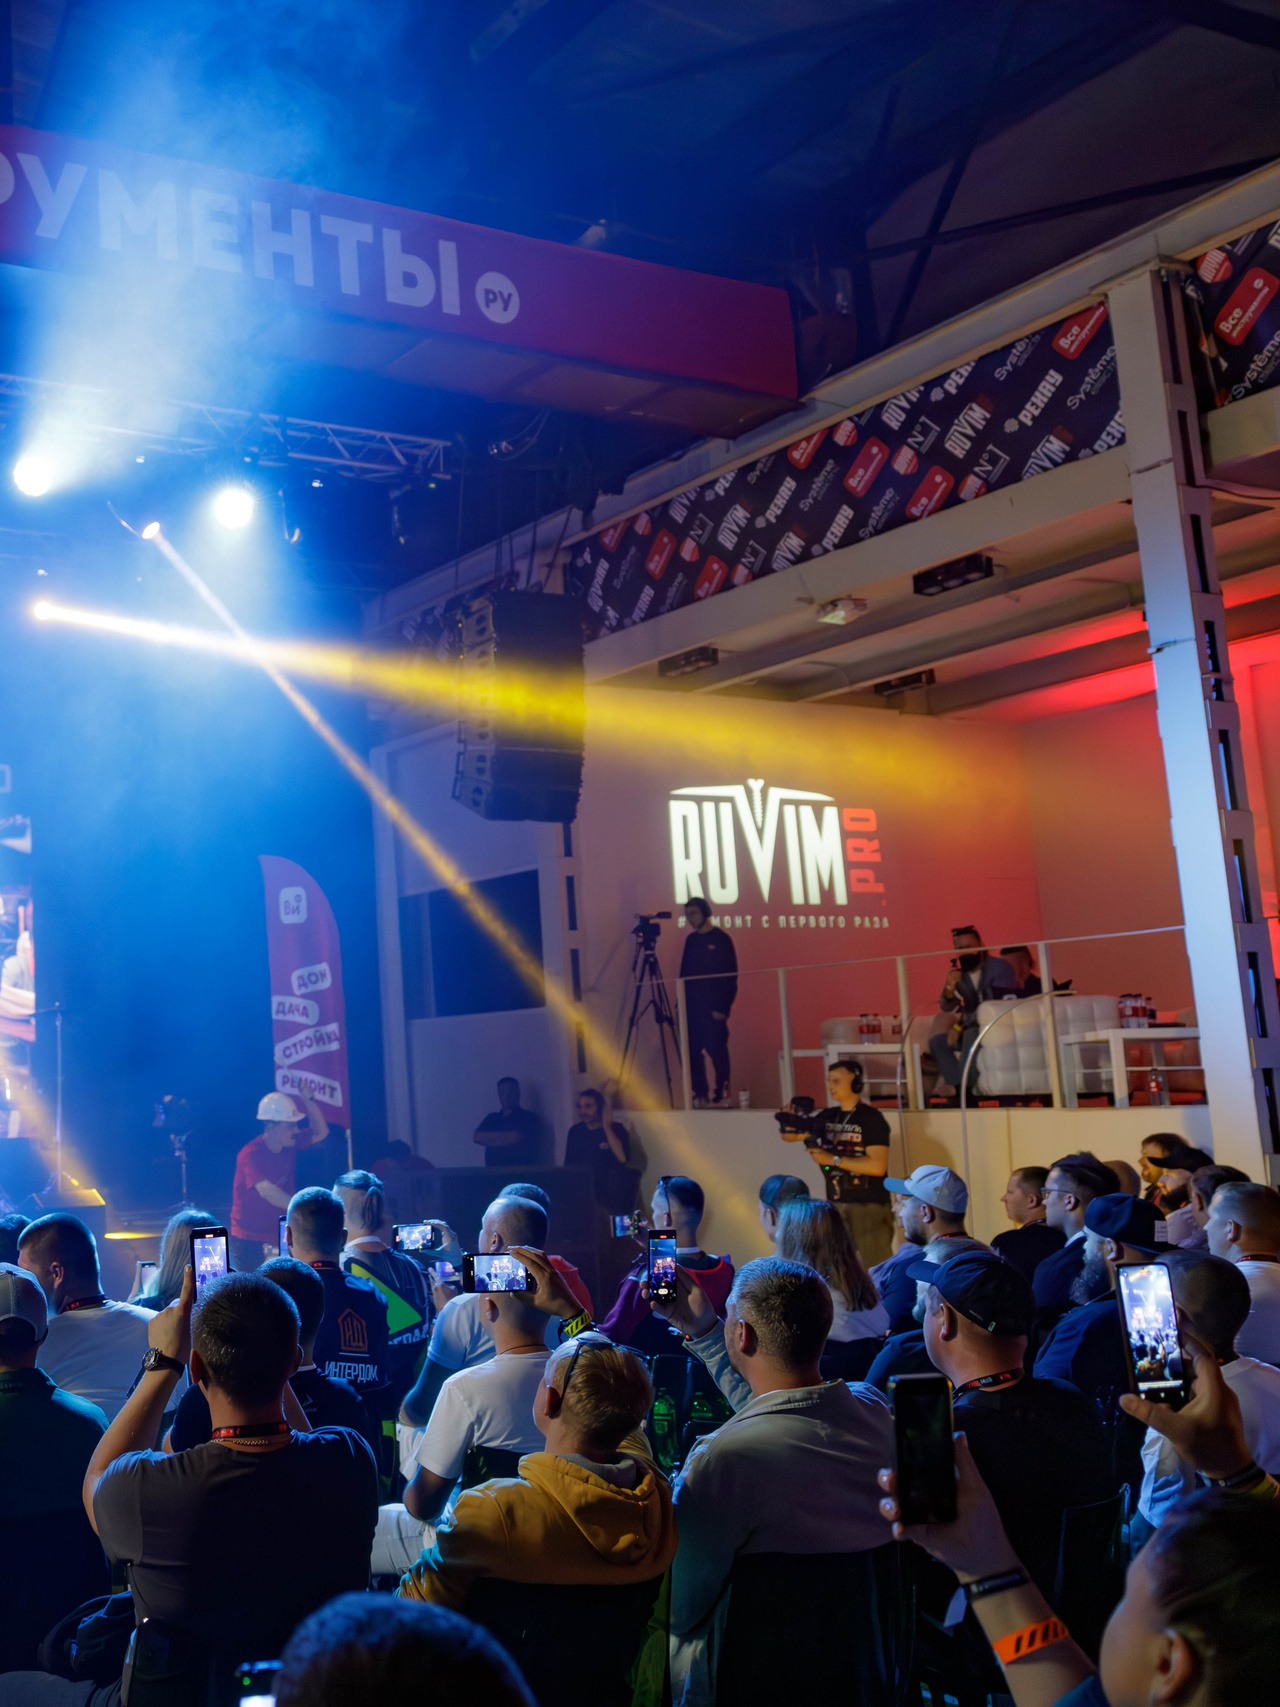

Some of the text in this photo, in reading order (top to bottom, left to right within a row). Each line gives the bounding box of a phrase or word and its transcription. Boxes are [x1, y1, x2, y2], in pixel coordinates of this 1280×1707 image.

[944, 401, 991, 460] RUVIM
[668, 784, 848, 906] RUVIM
[778, 915, 846, 929] ПЕРВОГО
[853, 915, 890, 929] РАЗА
[275, 1001, 310, 1019] ДАЧА
[324, 1360, 380, 1384] ИНТЕРДОМ
